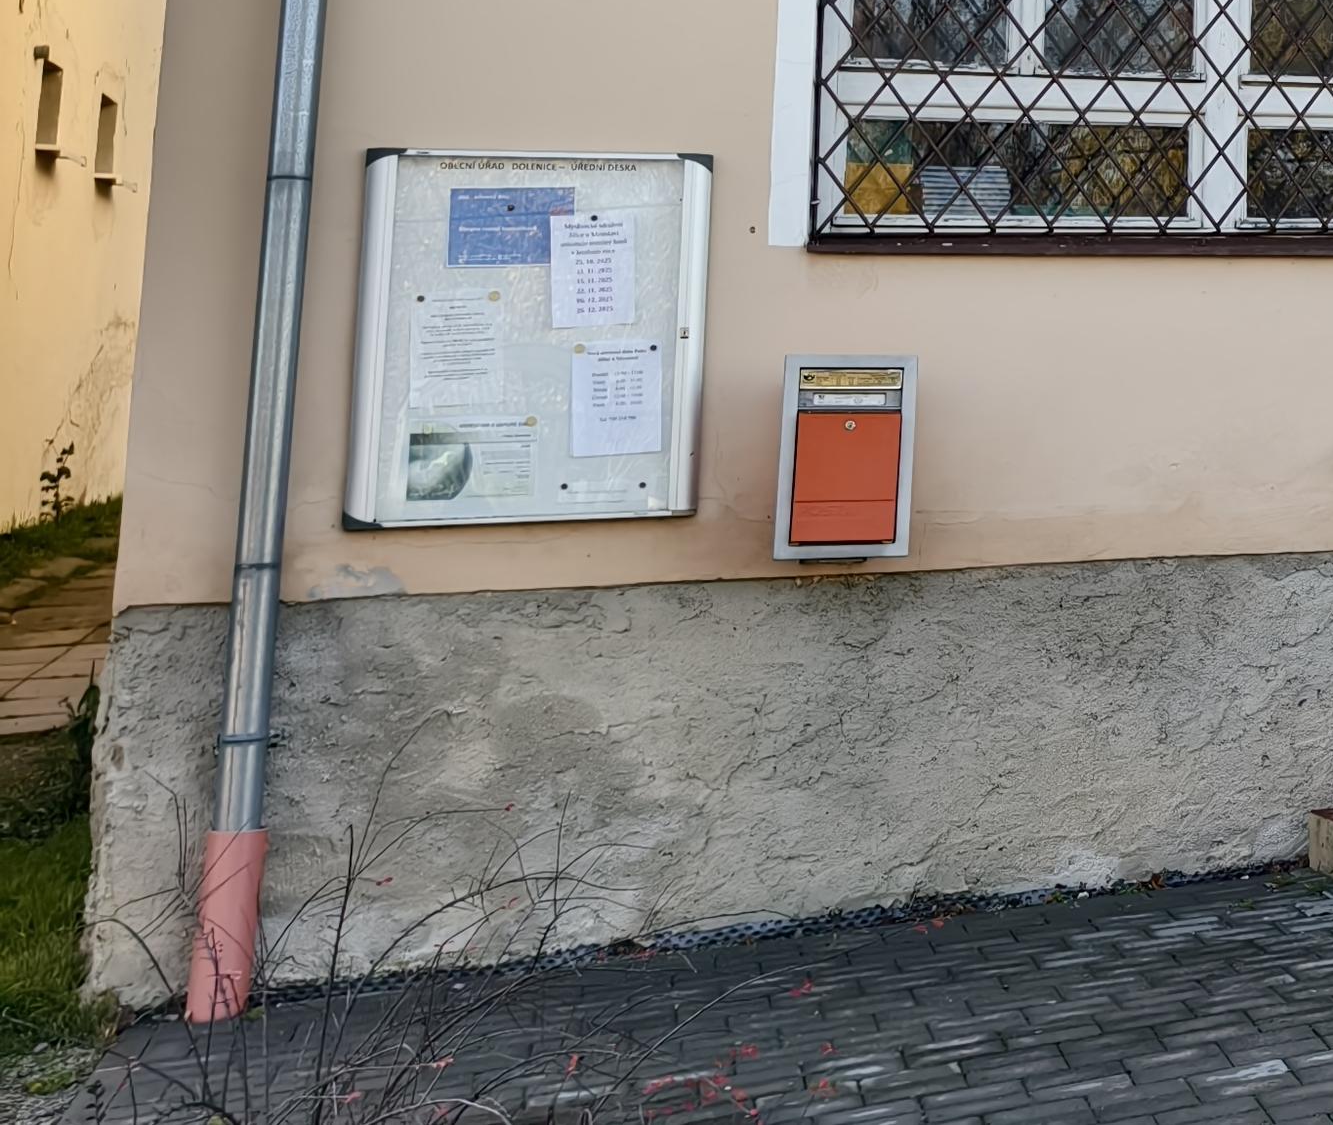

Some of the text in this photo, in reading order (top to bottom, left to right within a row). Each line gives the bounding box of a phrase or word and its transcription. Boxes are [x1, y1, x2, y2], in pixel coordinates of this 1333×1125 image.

[439, 161, 476, 170] OBECNÍ
[511, 162, 557, 171] DOLENICE
[608, 163, 637, 172] DESKA
